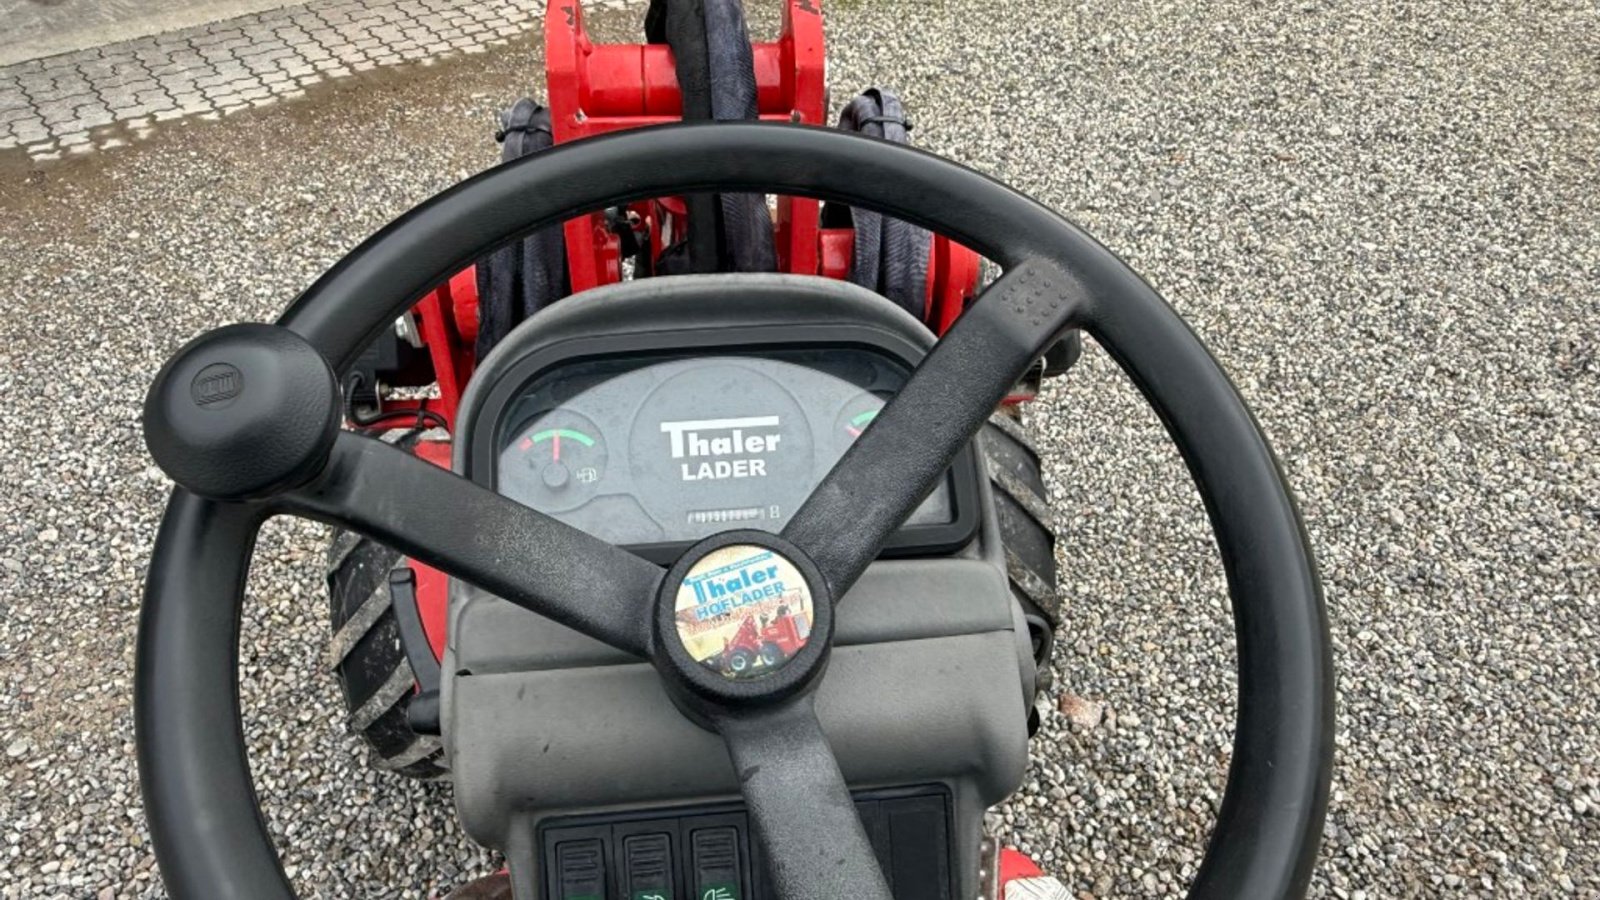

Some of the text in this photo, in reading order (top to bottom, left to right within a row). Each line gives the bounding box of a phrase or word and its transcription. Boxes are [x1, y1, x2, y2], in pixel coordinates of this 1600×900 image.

[661, 416, 780, 458] Thaler
[681, 459, 767, 481] LADER
[682, 551, 778, 605] Thaler
[695, 581, 786, 620] HOFLADER
